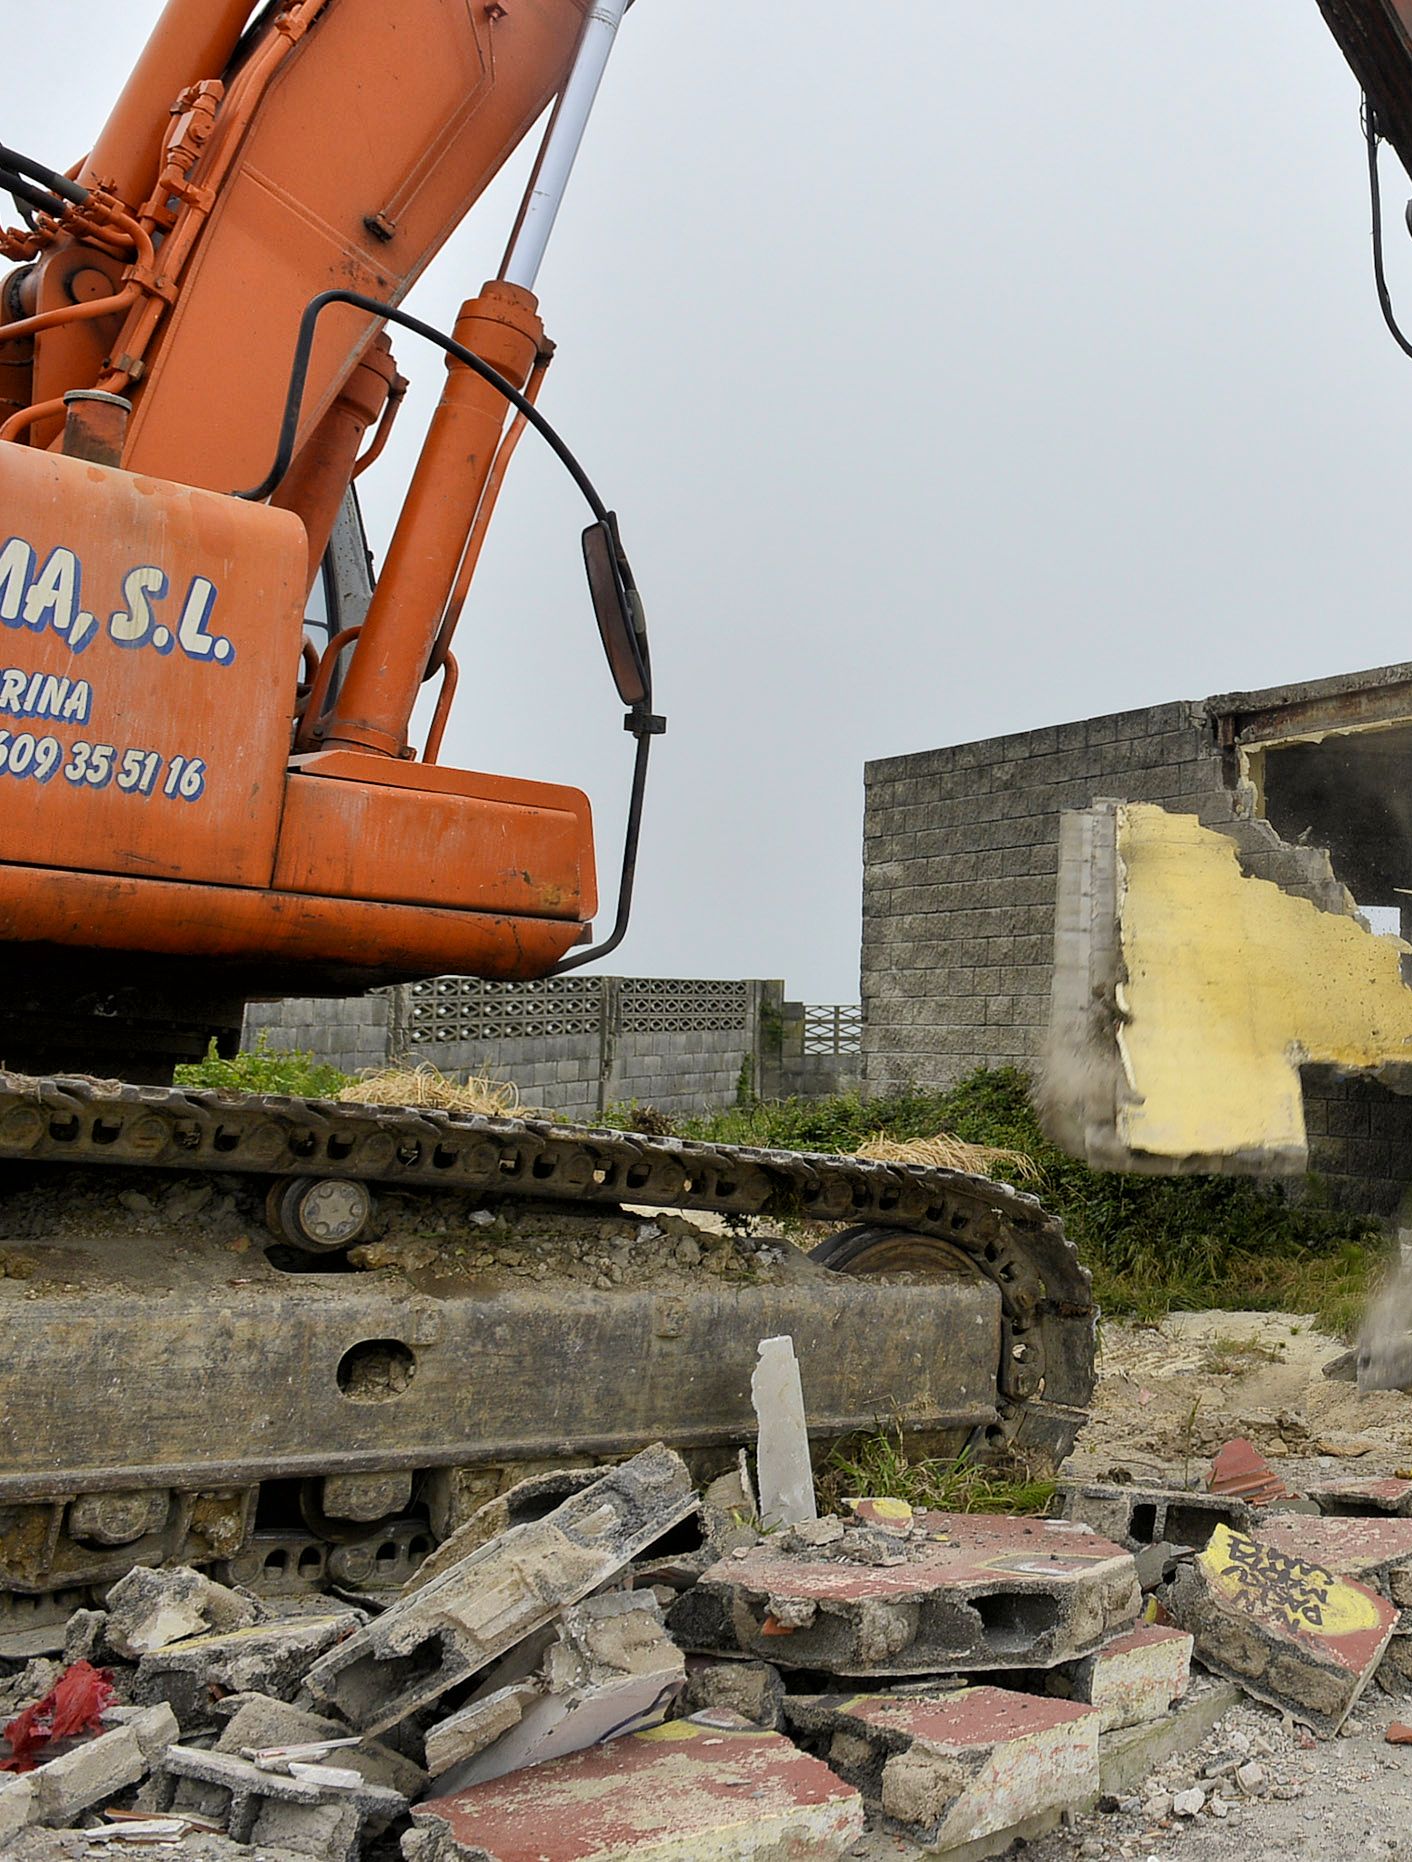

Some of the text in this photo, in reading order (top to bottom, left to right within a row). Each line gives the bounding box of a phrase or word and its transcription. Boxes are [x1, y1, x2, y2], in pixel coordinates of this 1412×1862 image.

[108, 565, 234, 664] S.L.
[64, 741, 115, 786] 35
[116, 748, 161, 795] 51
[163, 755, 205, 801] 16
